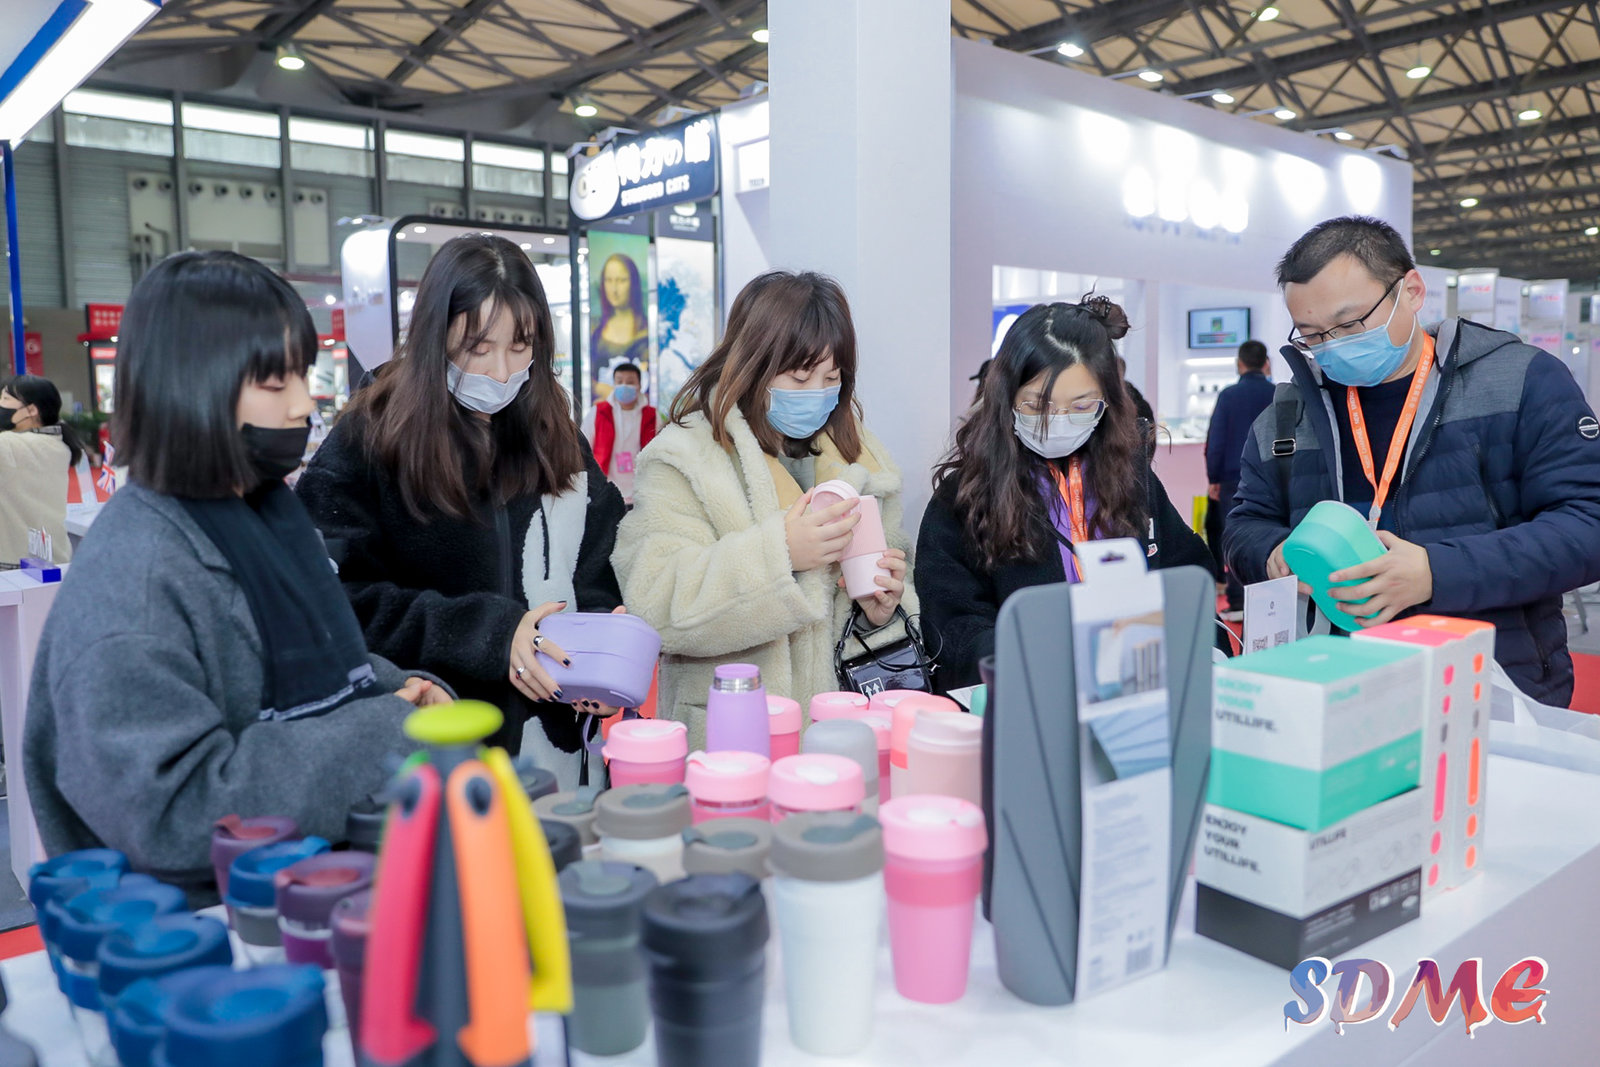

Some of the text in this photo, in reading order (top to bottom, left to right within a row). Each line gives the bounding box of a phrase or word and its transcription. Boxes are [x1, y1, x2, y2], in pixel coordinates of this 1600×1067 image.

[1206, 814, 1247, 834] ENJOY
[1205, 829, 1239, 849] YOUR
[1204, 845, 1261, 874] UTILLIFE.
